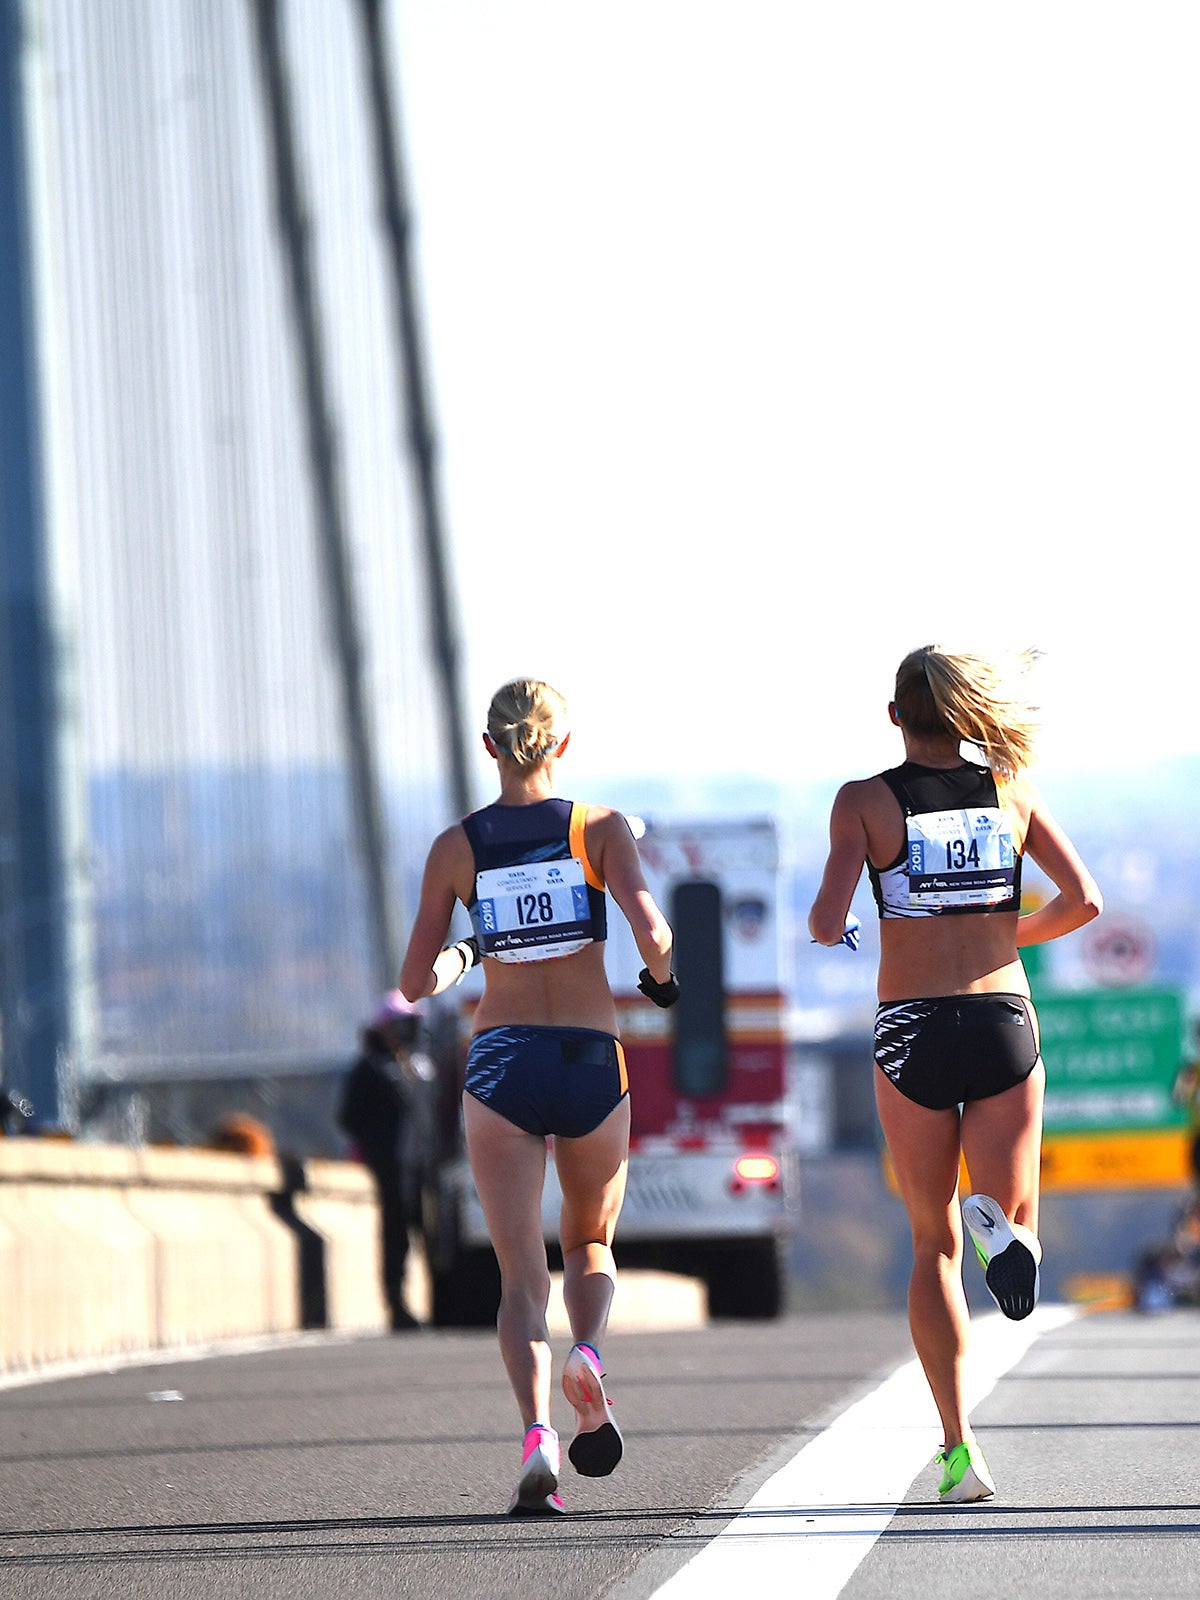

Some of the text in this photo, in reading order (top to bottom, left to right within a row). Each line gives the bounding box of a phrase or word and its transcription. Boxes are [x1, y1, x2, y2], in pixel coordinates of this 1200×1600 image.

[911, 844, 921, 871] 2019
[947, 839, 980, 869] 134
[481, 901, 494, 931] 2019
[515, 892, 553, 926] 128
